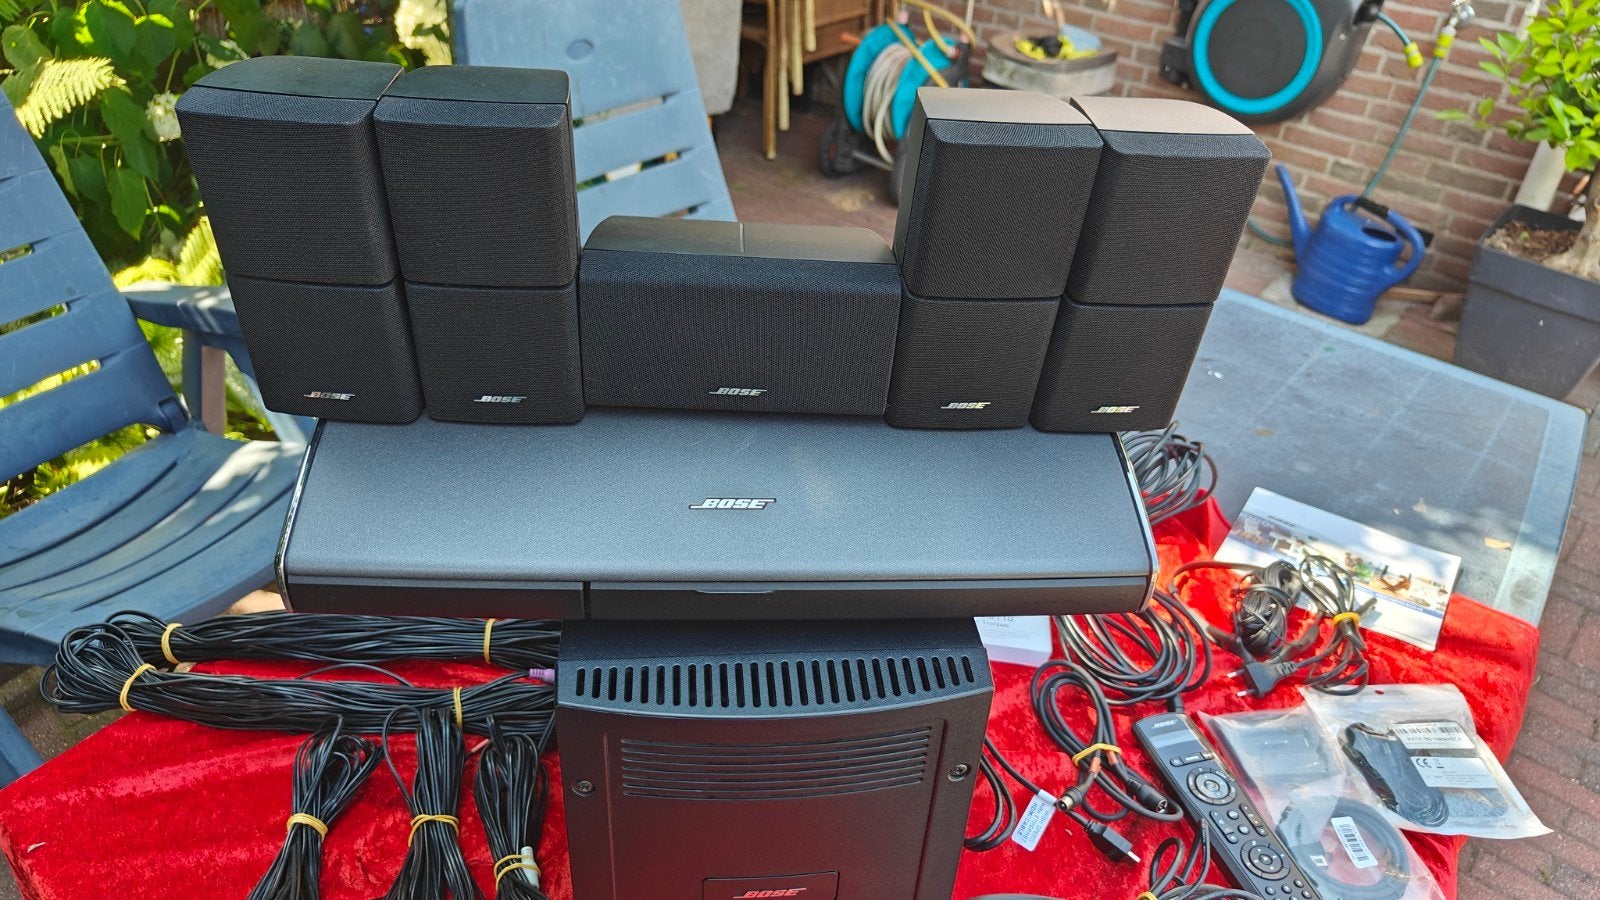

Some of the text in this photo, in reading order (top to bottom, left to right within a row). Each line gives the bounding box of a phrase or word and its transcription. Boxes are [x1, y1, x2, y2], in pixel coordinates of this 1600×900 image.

[303, 390, 356, 401] BOSE
[709, 386, 767, 397] BOSE
[474, 395, 527, 404] BOSE
[940, 401, 992, 411] BOSE
[1090, 405, 1141, 414] BOSE
[688, 497, 777, 511] BOSE
[733, 887, 807, 899] BOSE
